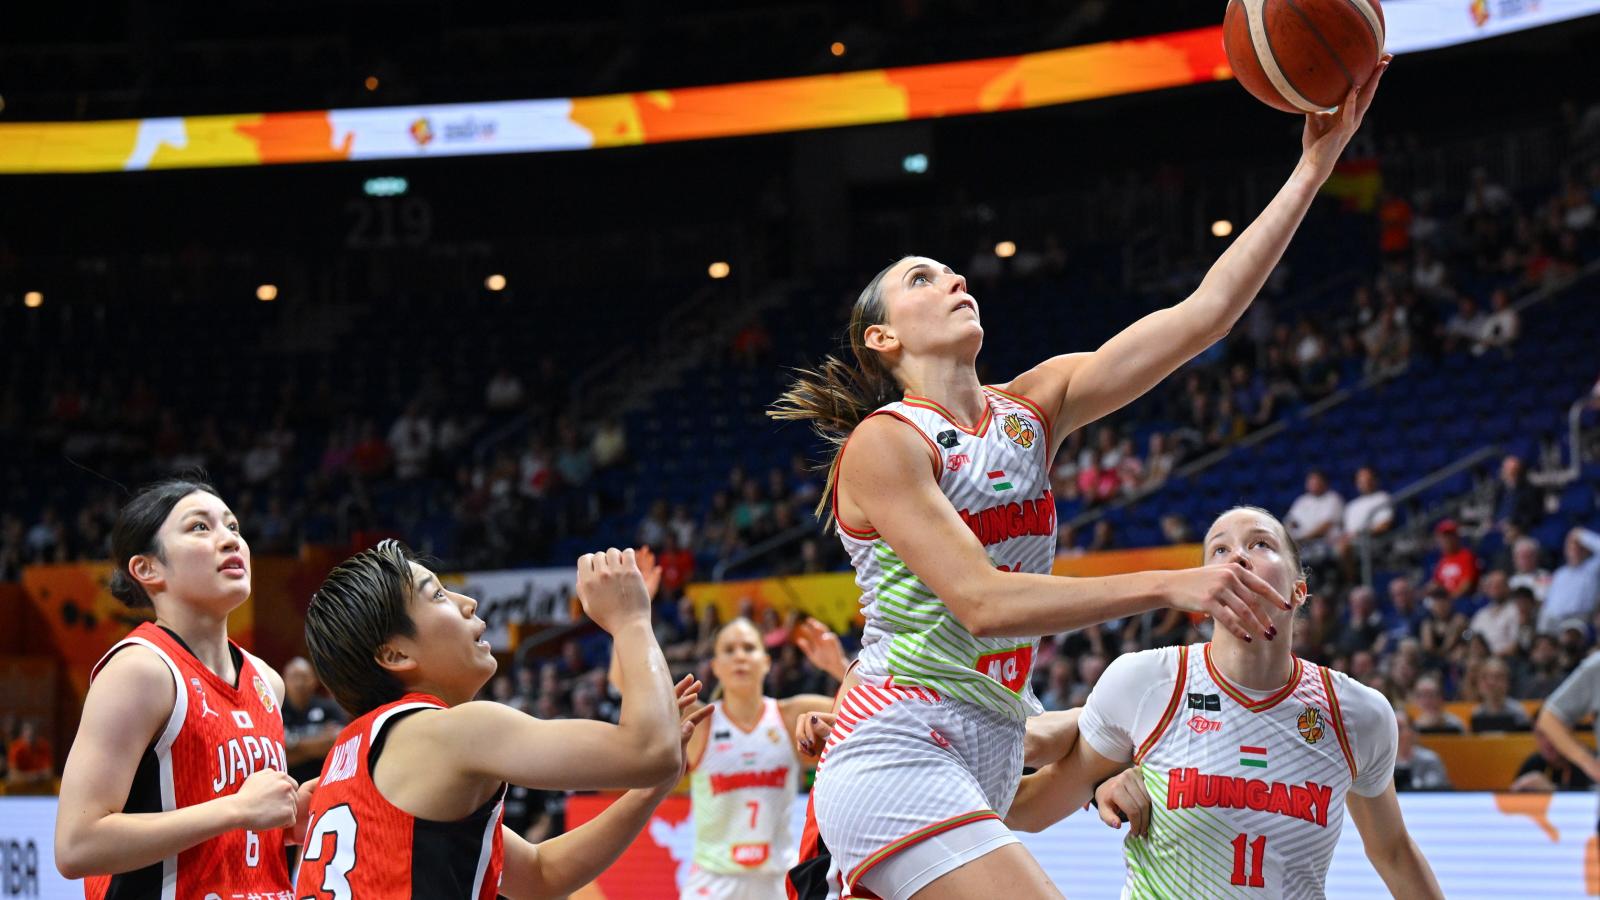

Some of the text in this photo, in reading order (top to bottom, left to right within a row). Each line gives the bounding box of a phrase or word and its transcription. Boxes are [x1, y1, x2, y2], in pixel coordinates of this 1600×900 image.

[345, 198, 431, 247] 219
[746, 801, 760, 829] 7
[1166, 768, 1333, 828] HUNGARY
[0, 838, 40, 899] IBA
[245, 829, 260, 868] 6
[1230, 832, 1267, 888] 11
